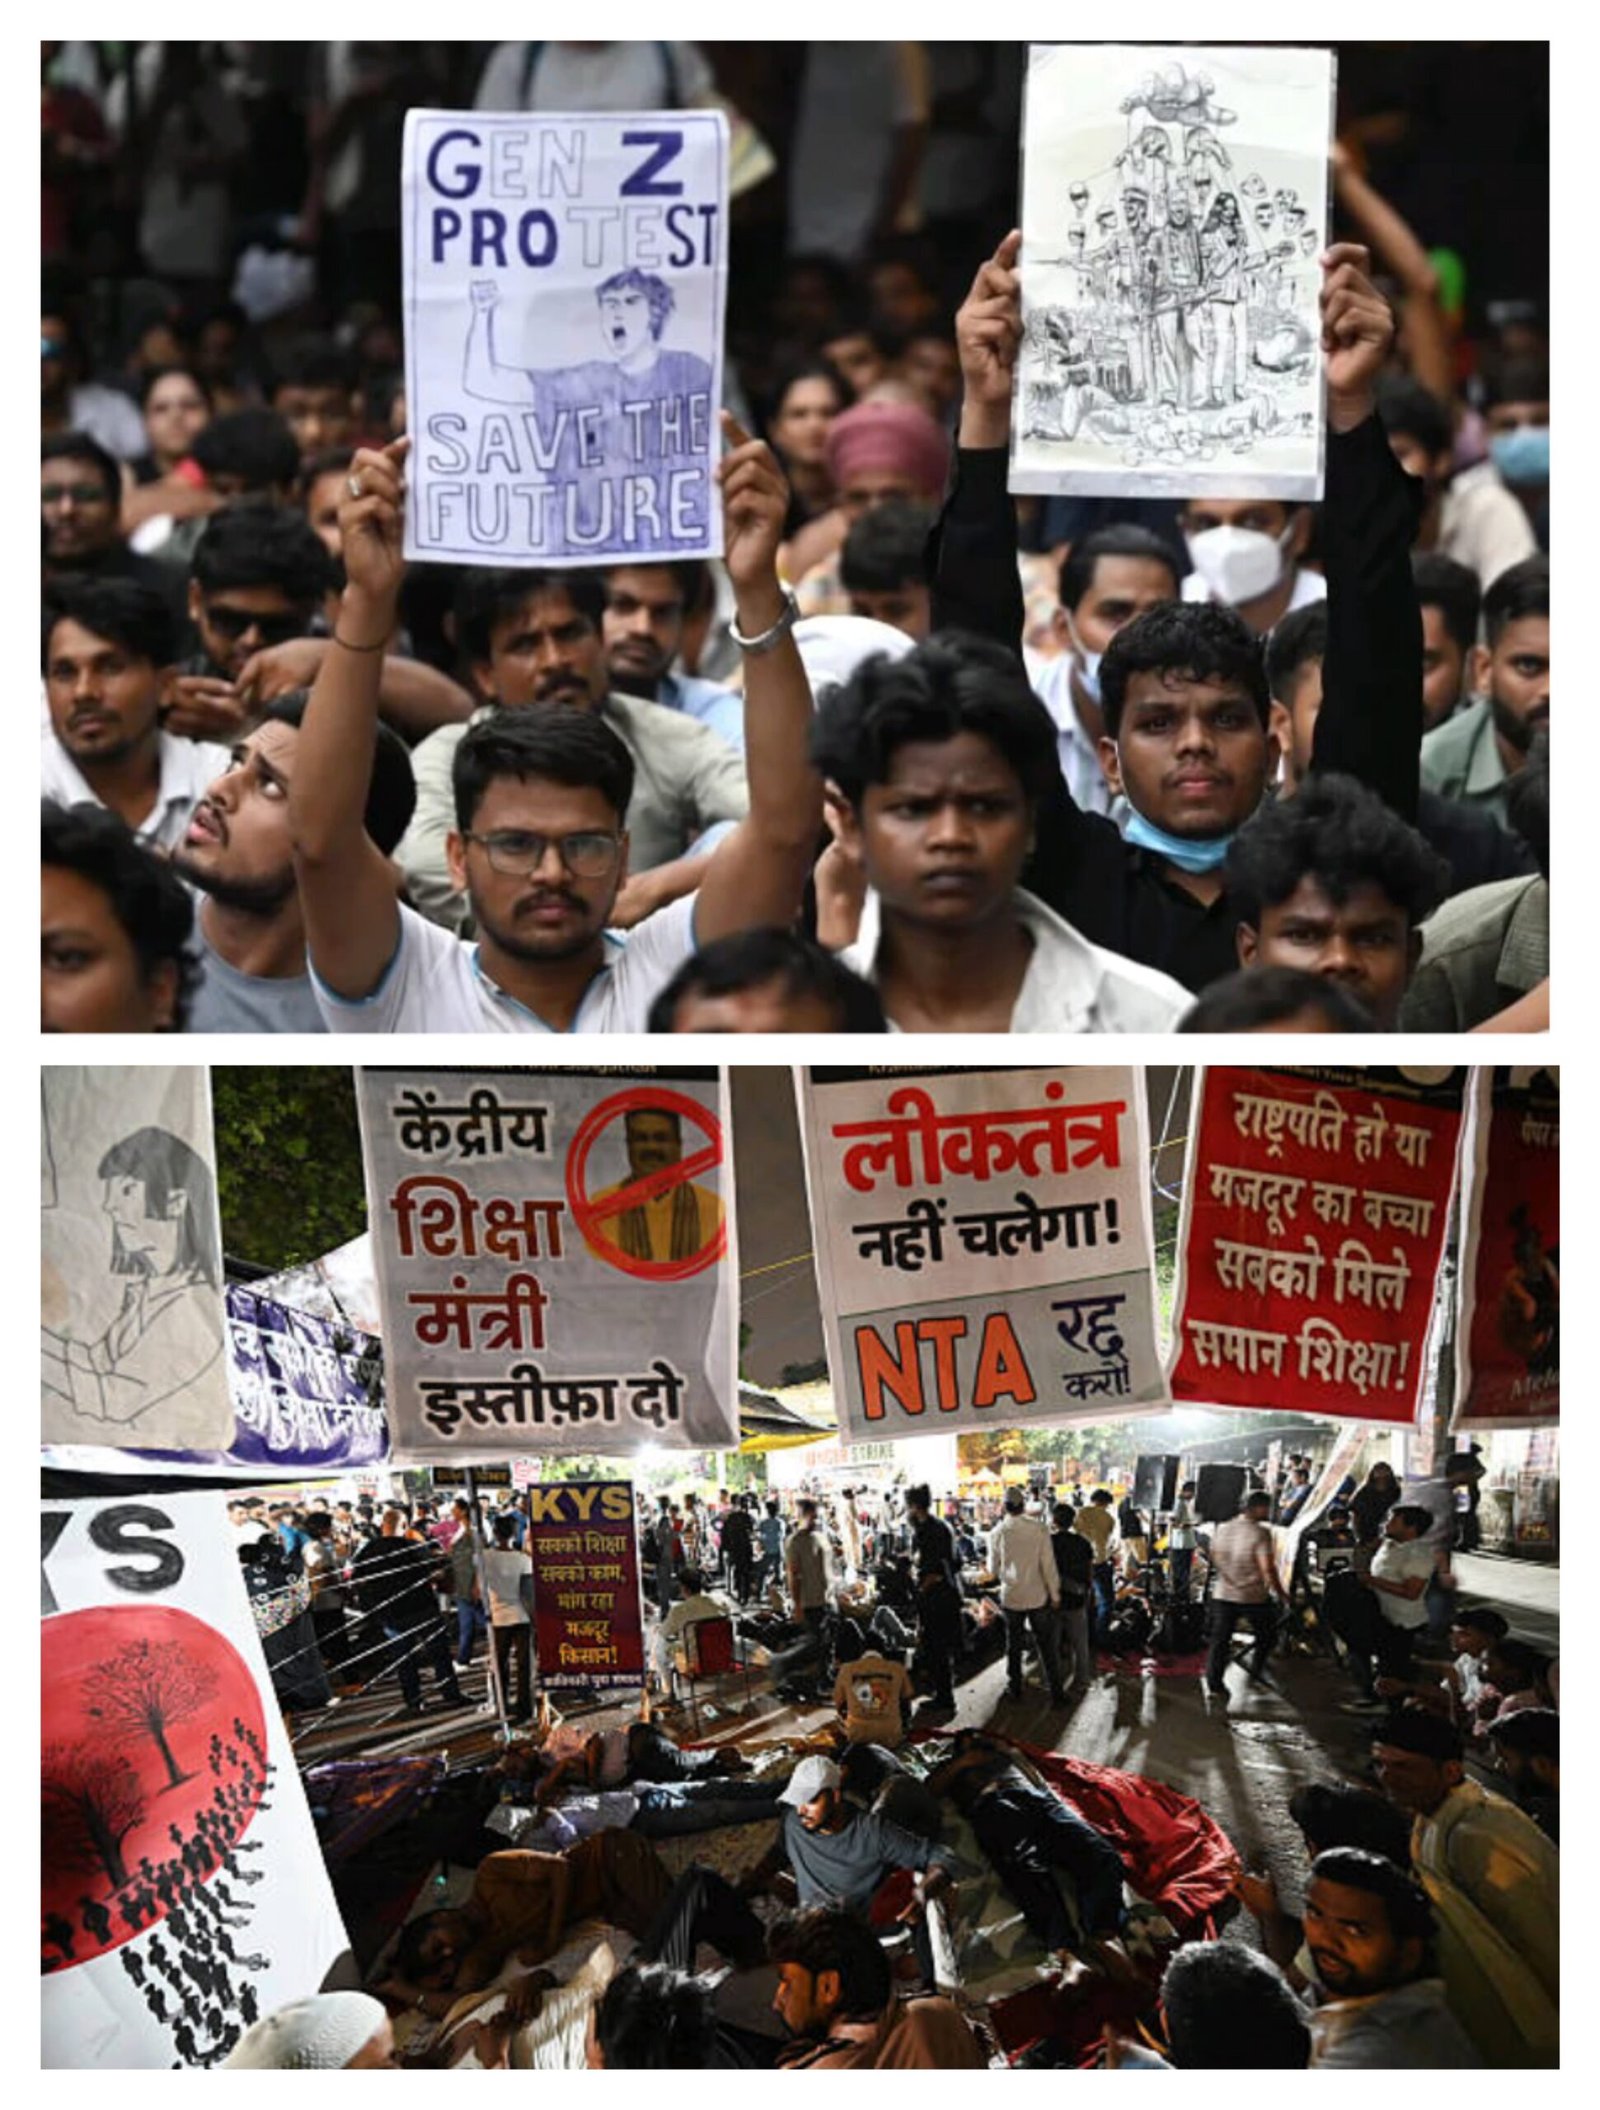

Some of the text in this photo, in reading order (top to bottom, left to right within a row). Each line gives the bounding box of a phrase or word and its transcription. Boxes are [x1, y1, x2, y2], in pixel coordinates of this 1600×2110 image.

[427, 130, 685, 199] GEN Z
[432, 204, 719, 268] PROTEST
[427, 393, 709, 474] SAVE THE
[427, 469, 708, 547] FUTURE
[393, 1089, 548, 1157] केंद्रीय
[1233, 1090, 1432, 1168] राष्ट्रपति हो या
[390, 1176, 565, 1262] शिक्षा
[852, 1198, 948, 1271] नहीं
[1208, 1163, 1436, 1239] मजदूर का बच्चा
[1213, 1234, 1411, 1312] सबको मिले
[407, 1273, 548, 1350] मंत्री
[1186, 1318, 1288, 1378] समान
[626, 1361, 684, 1428] दो
[855, 1312, 1037, 1421] NTA
[529, 1485, 633, 1522] KYS
